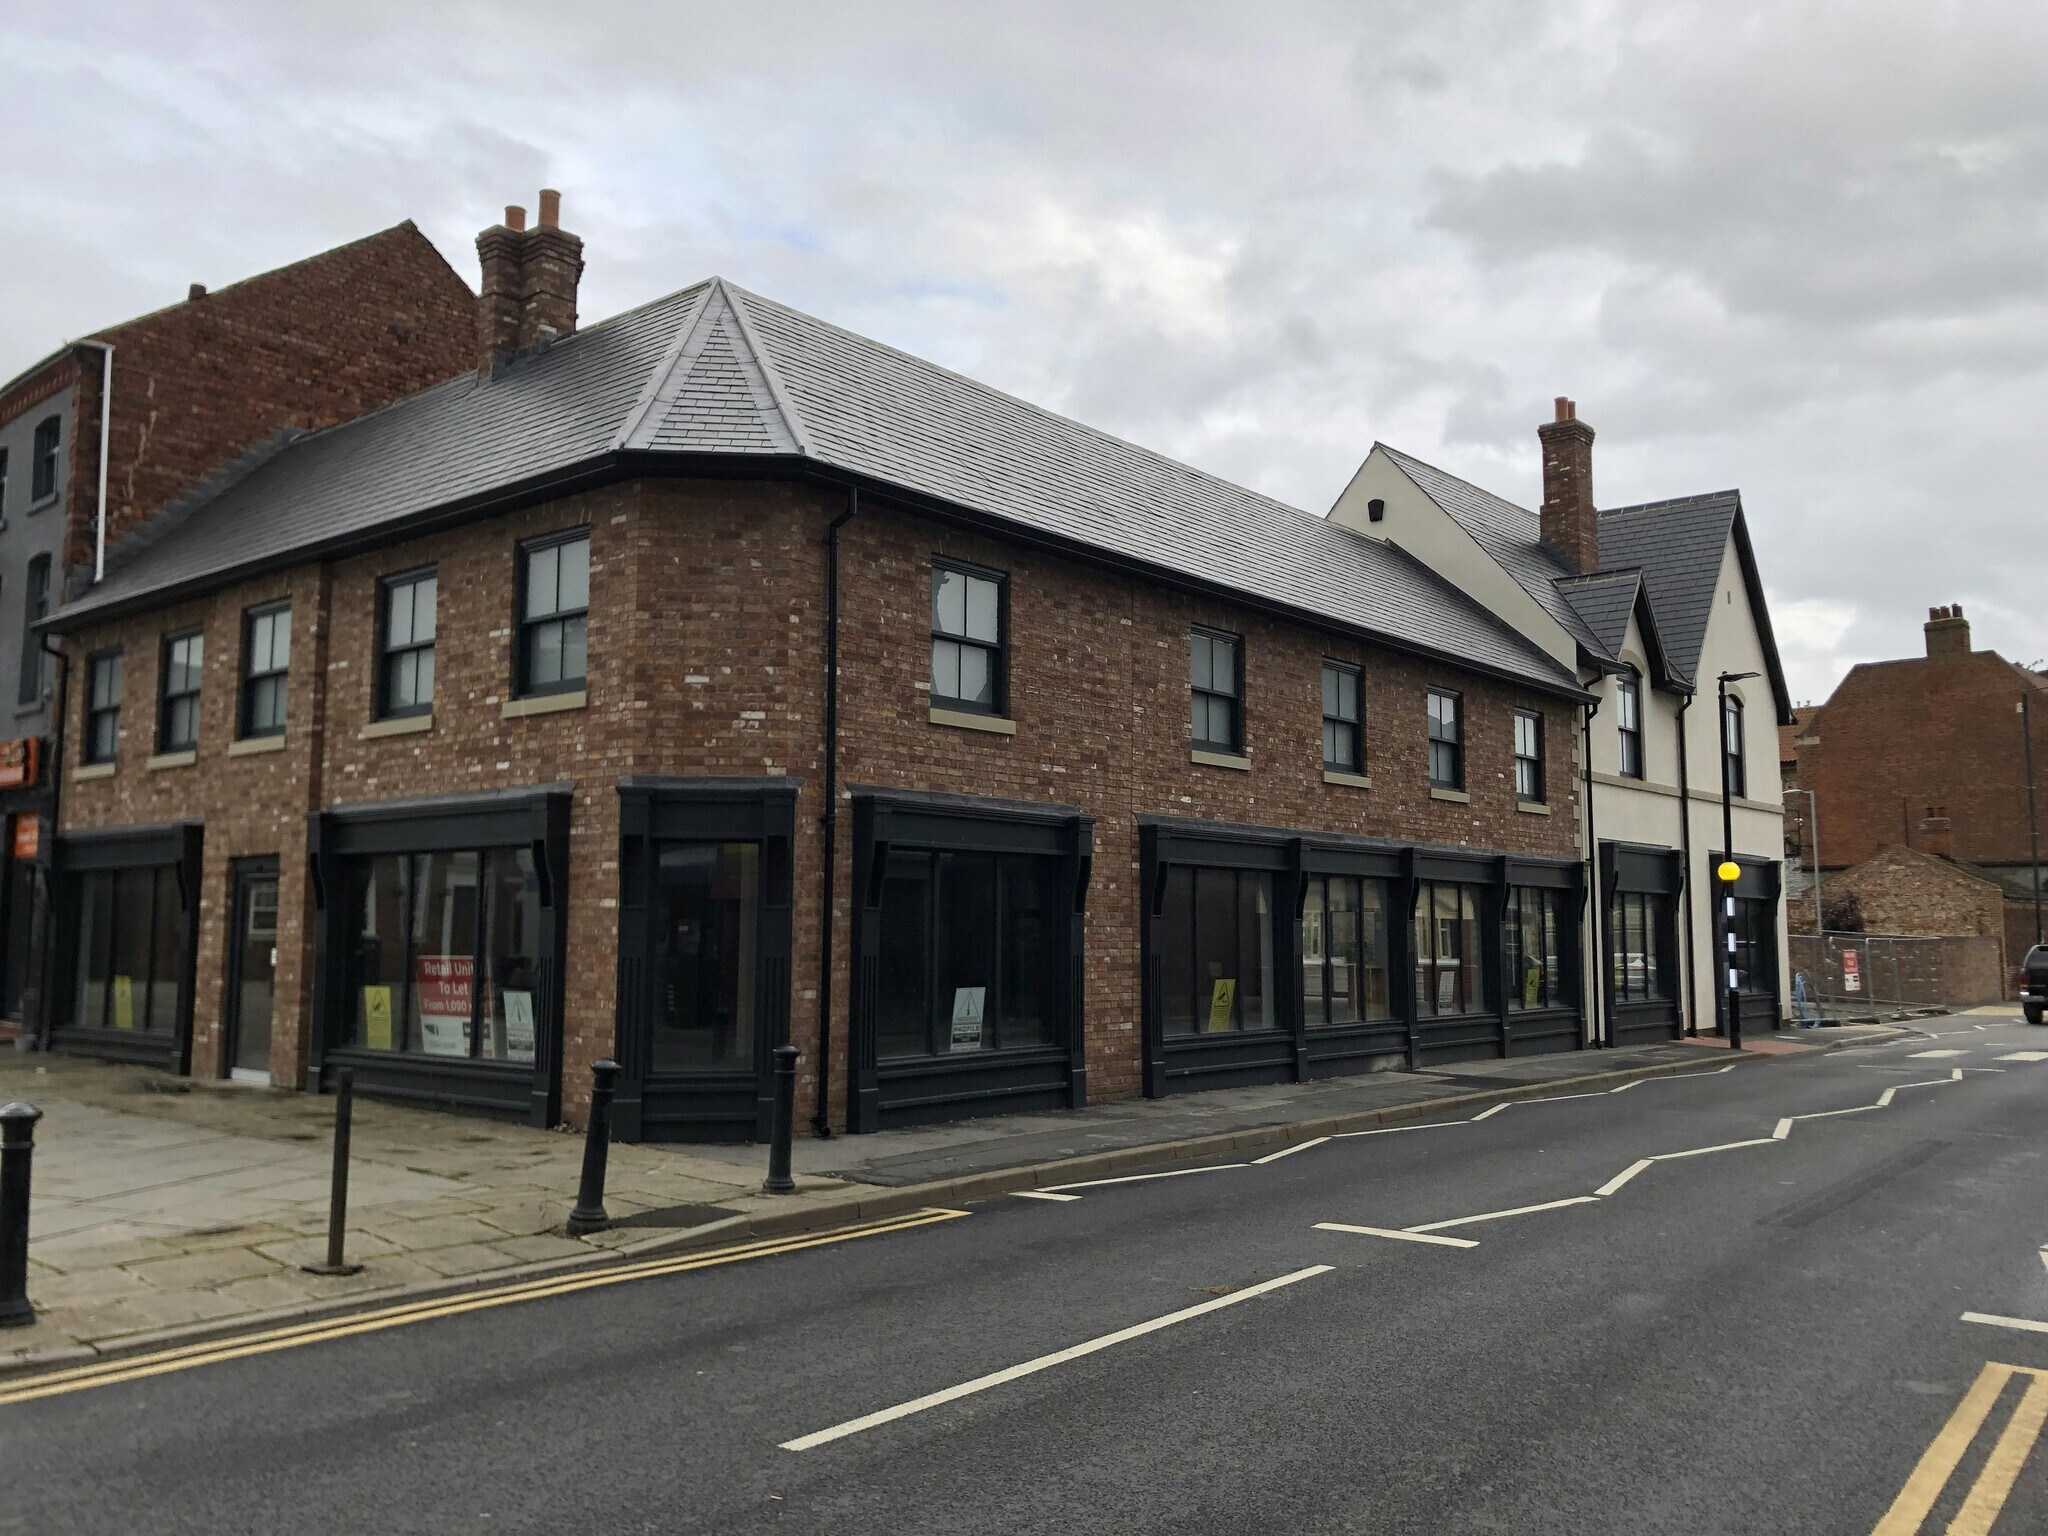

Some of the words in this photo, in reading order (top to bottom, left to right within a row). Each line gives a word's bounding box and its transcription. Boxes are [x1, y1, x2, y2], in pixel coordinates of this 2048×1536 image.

[424, 961, 453, 977] Retail
[439, 981, 449, 995] To
[453, 982, 468, 996] Let
[424, 998, 444, 1010] From
